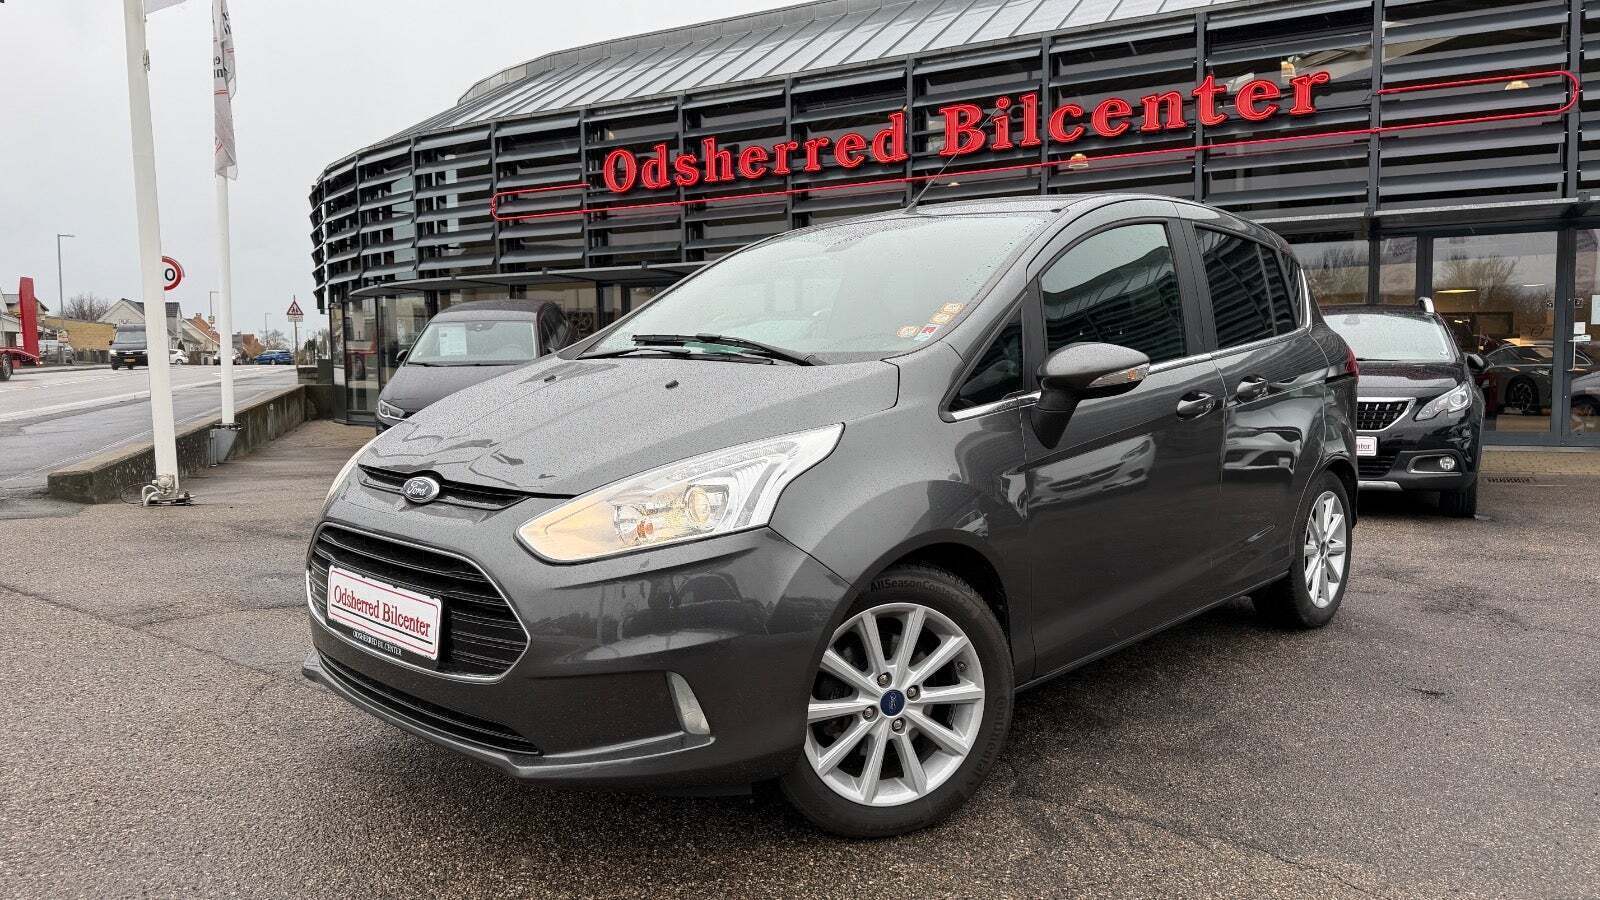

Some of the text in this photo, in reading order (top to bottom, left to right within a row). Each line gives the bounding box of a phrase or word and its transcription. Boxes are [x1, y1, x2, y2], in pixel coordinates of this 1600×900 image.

[603, 70, 1331, 193] Odsherred Bilcenter
[164, 267, 176, 282] 0
[406, 480, 429, 495] Ford
[334, 585, 431, 638] Odsherred Bilcenter
